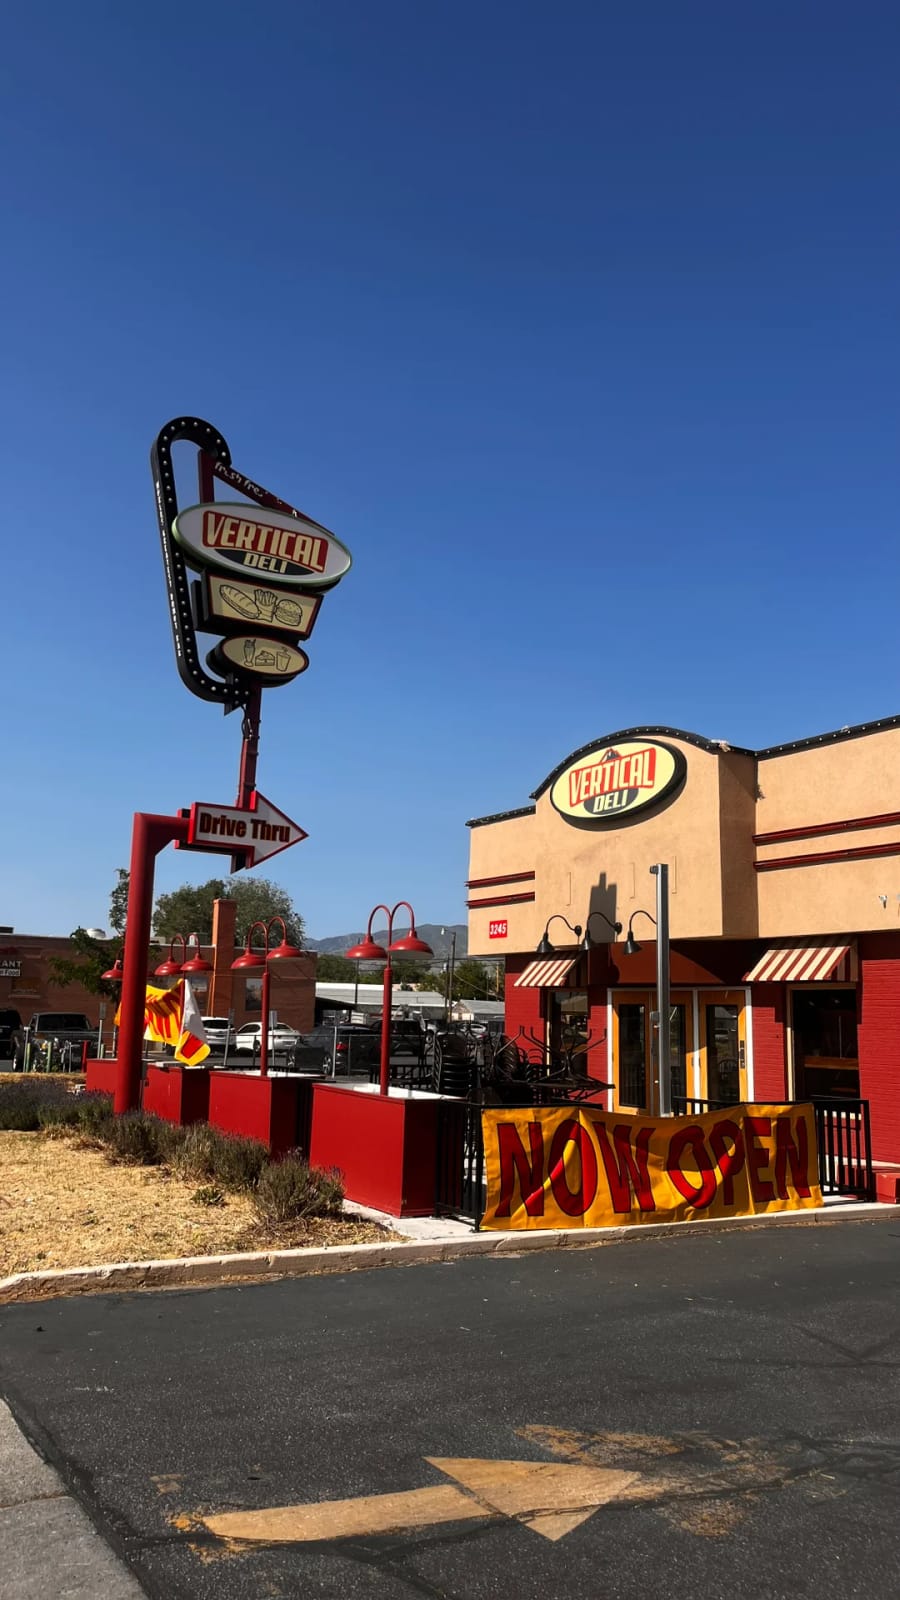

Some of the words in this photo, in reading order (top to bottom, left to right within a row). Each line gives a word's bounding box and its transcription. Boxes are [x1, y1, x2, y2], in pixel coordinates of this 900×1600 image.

[207, 512, 324, 571] VERTICAL
[243, 552, 288, 574] DELI
[570, 751, 654, 805] VERTICAL
[593, 789, 629, 813] DELI
[199, 812, 247, 838] Drive
[250, 818, 291, 843] Thru
[490, 923, 506, 935] 3245
[0, 960, 22, 968] ANT
[494, 1118, 657, 1218] NOW
[666, 1116, 812, 1210] OPEN
